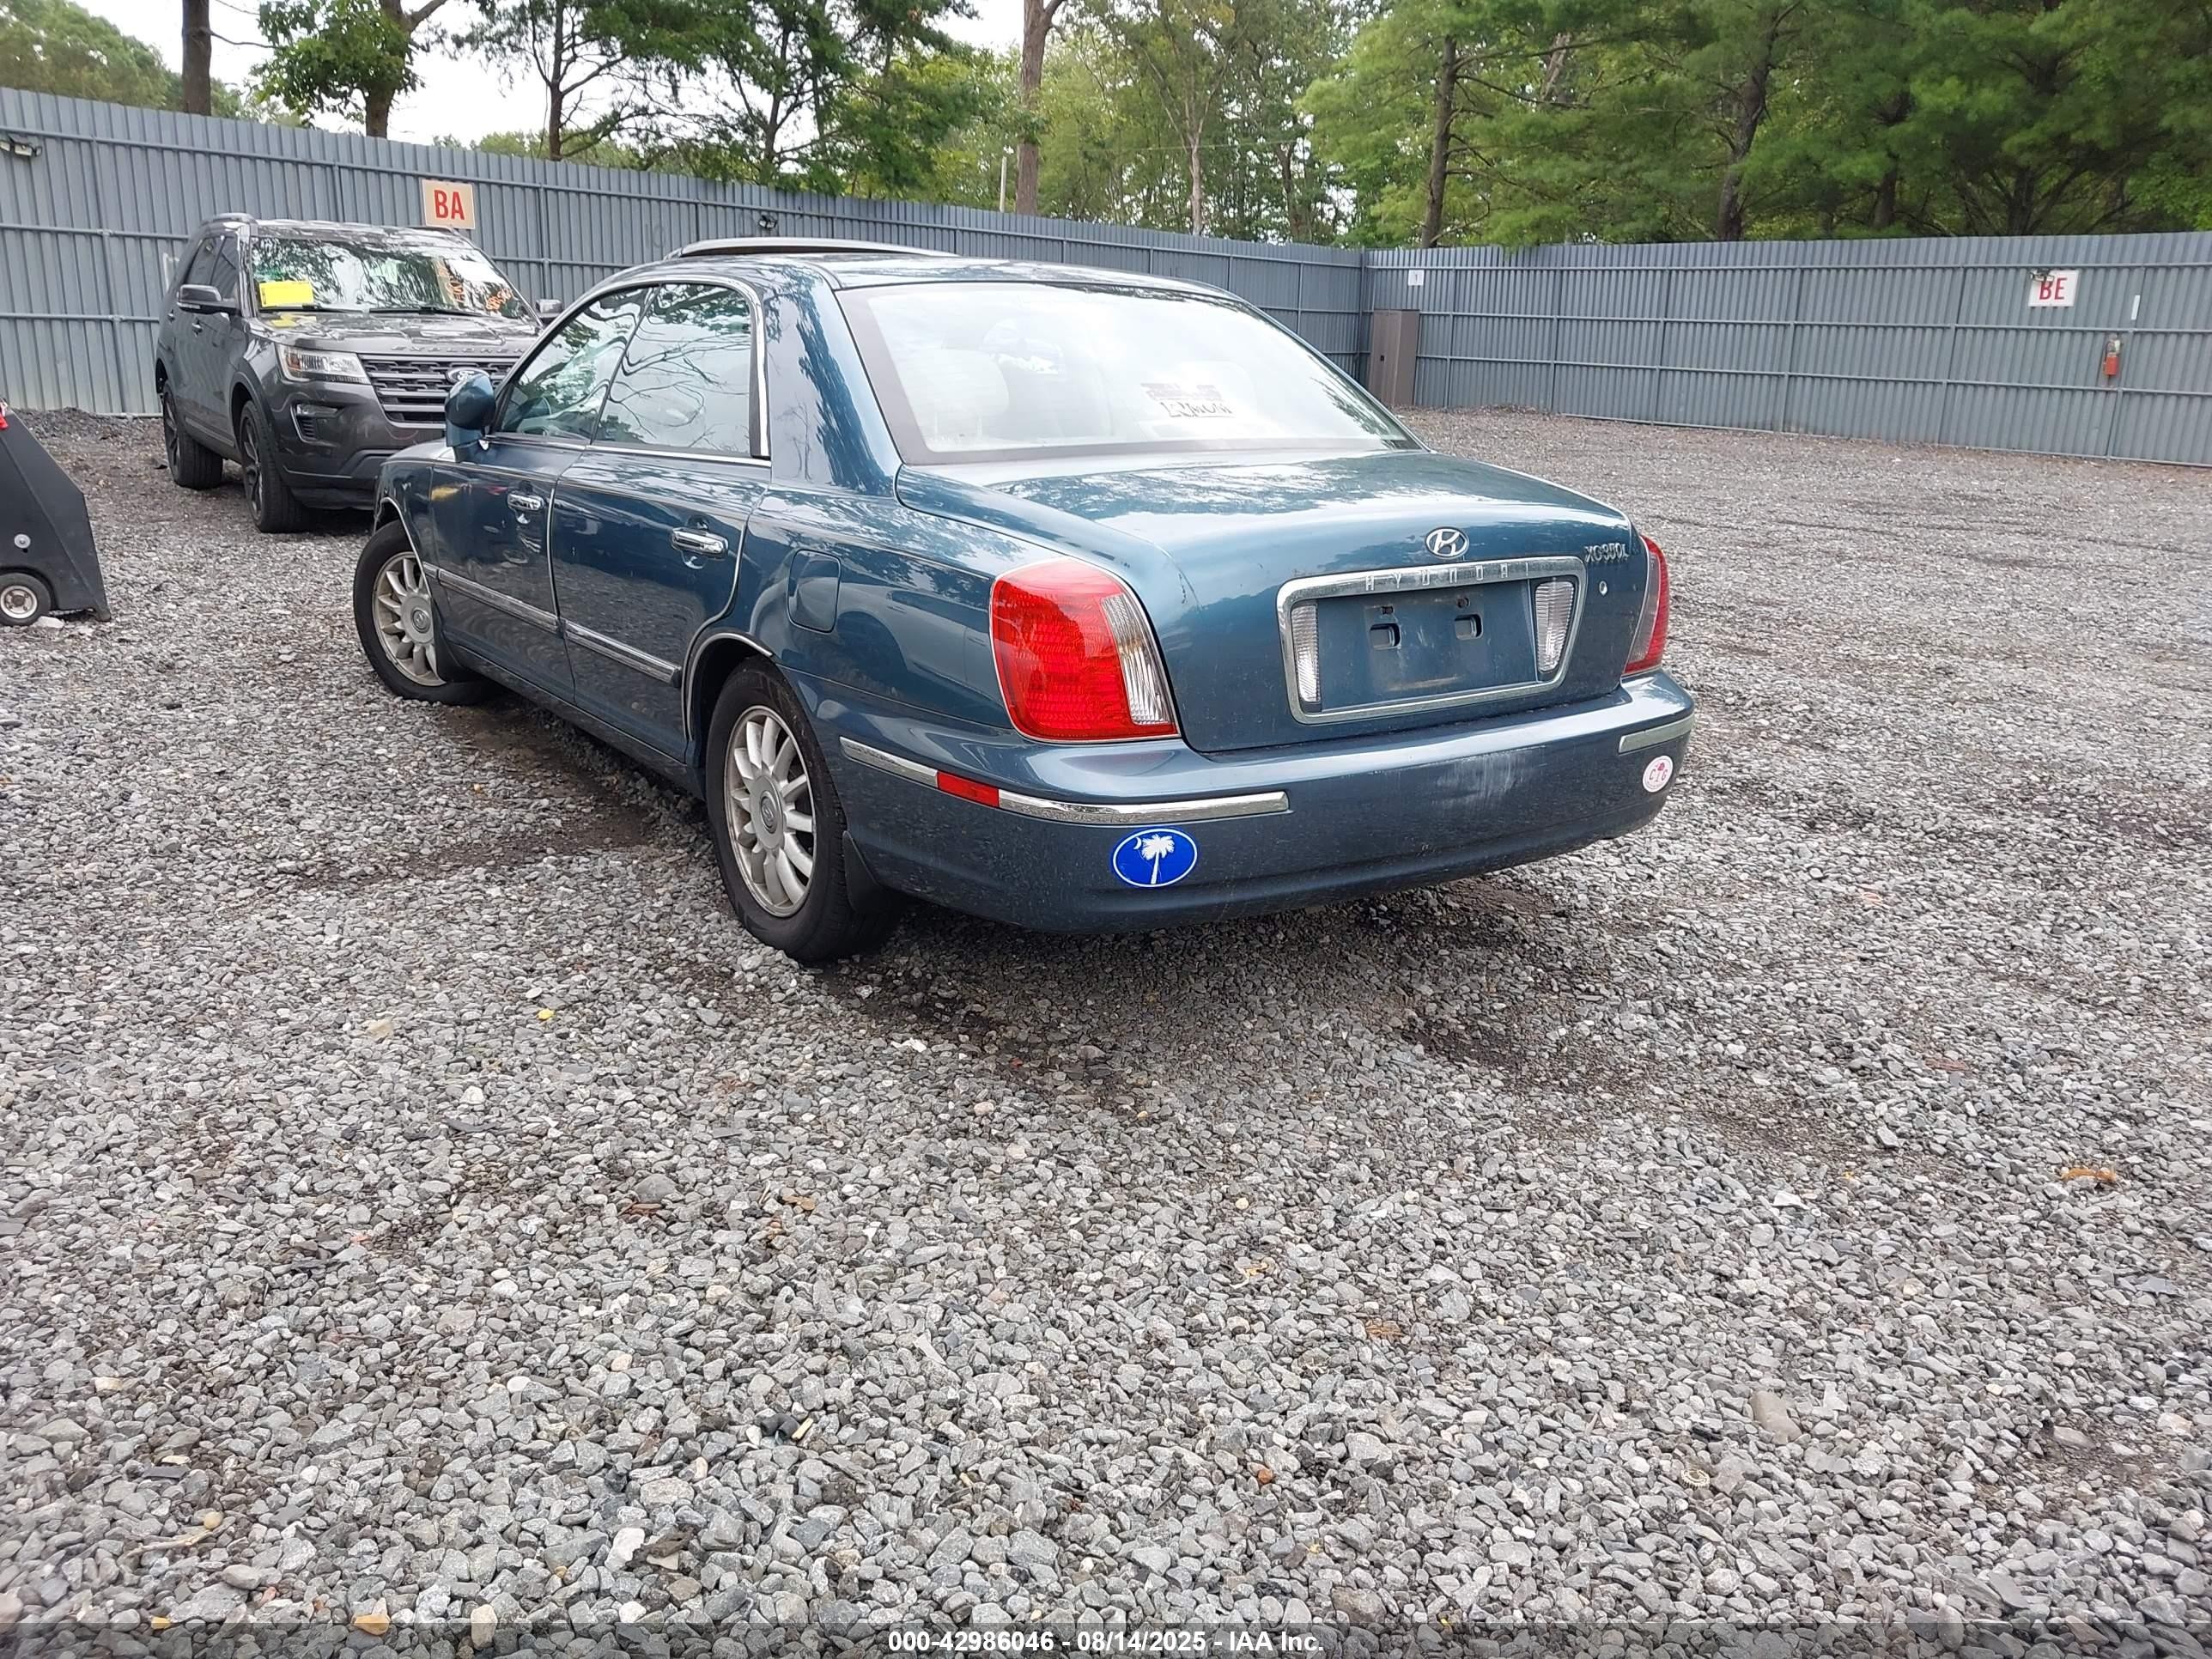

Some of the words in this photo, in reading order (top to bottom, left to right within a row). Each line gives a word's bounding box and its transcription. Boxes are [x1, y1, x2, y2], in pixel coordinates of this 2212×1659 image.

[434, 189, 465, 221] BA
[2039, 276, 2068, 301] BE
[1365, 562, 1528, 592] HYUNDAI
